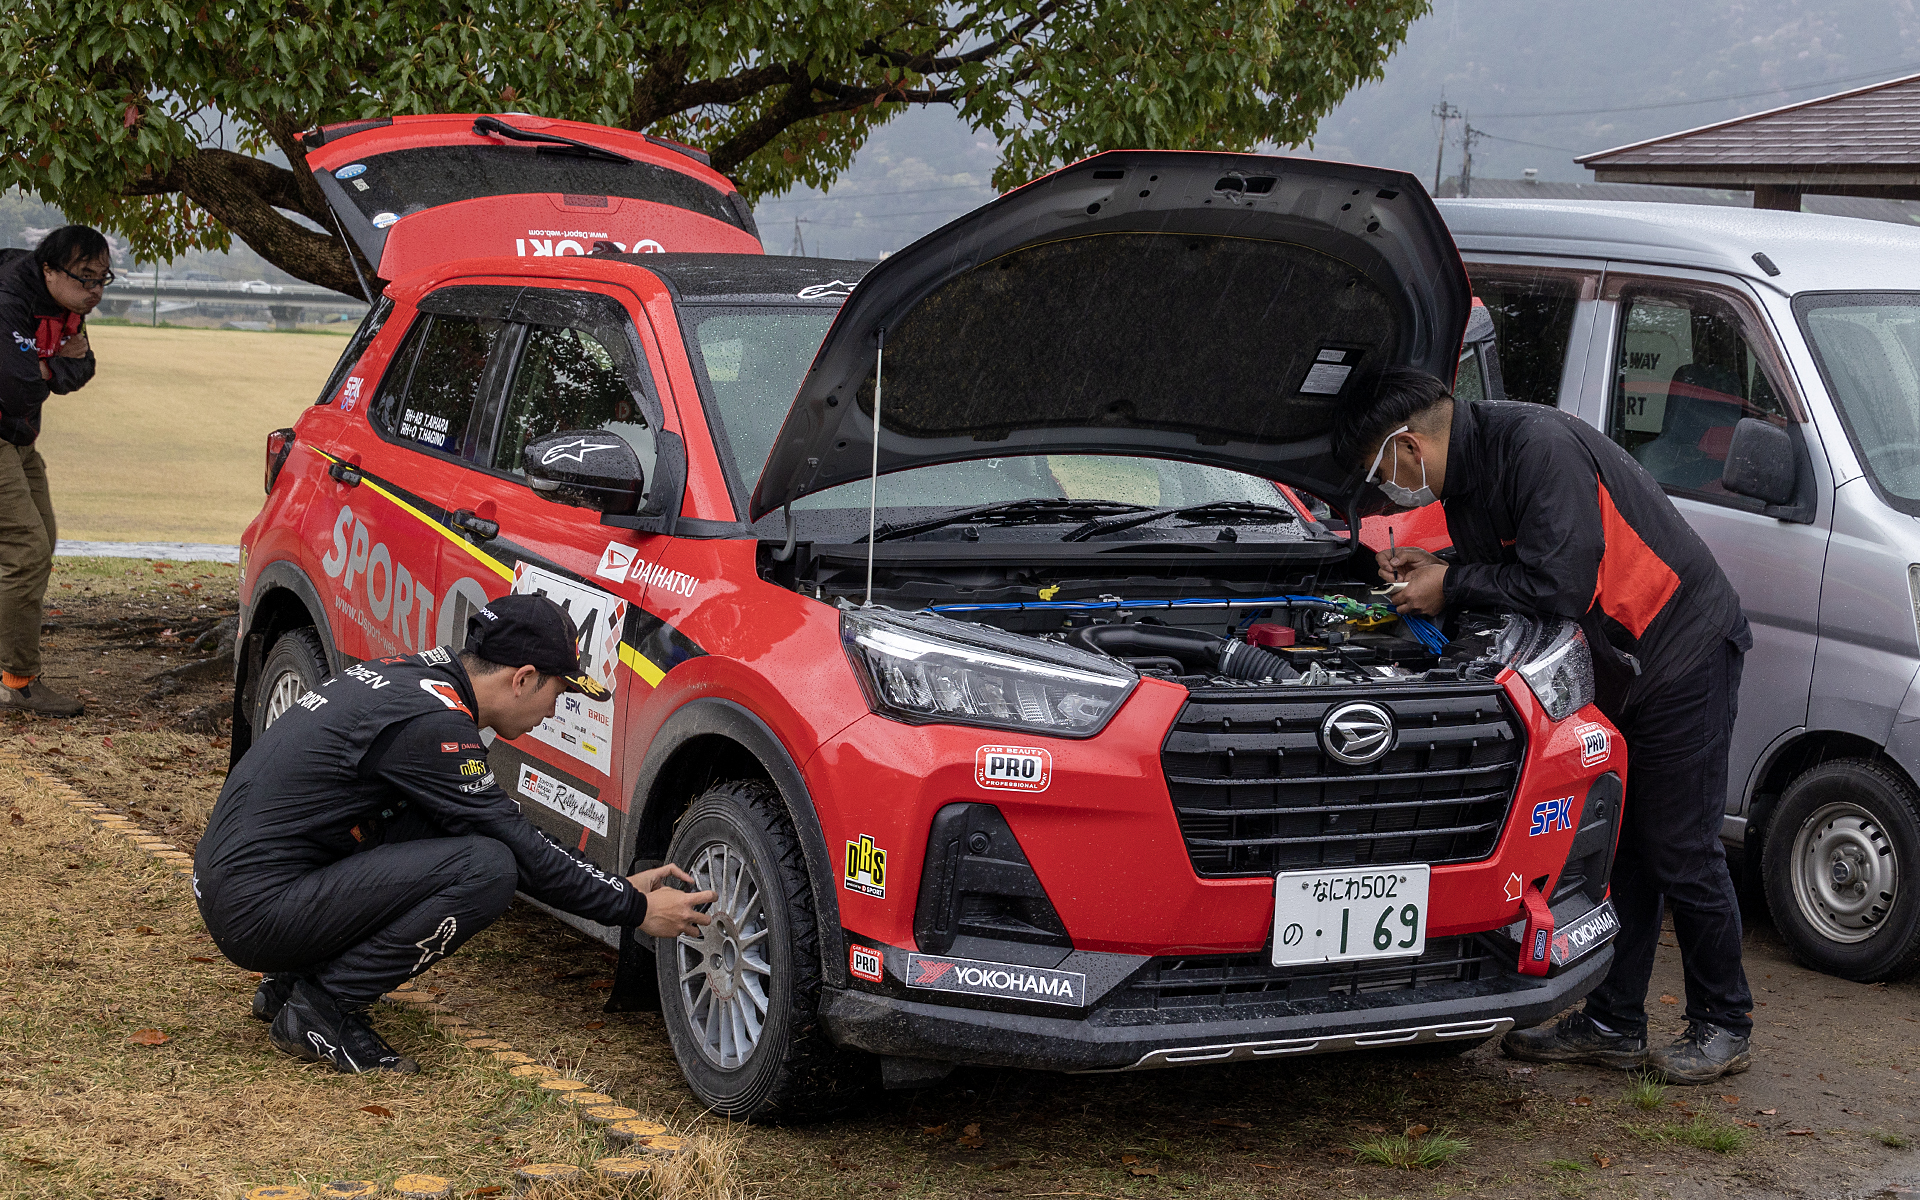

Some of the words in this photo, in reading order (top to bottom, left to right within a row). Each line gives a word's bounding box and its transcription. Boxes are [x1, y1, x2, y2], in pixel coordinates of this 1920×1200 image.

[528, 229, 608, 239] www.Dsport-web.com
[322, 505, 435, 652] SPORT
[631, 558, 700, 598] DAIHATSU
[565, 696, 581, 715] SPK
[588, 708, 610, 727] BRIDE
[1006, 747, 1043, 756] BEAUTY
[1585, 732, 1605, 755] PRO
[990, 756, 1035, 779] PRO
[985, 780, 1038, 789] PROFESSIONAL
[553, 784, 579, 817] Rally
[1529, 796, 1574, 837] SPK
[848, 836, 885, 885] DRS
[866, 886, 883, 896] SPORT
[1283, 922, 1304, 947] の
[1567, 911, 1616, 948] YOKOHAMA
[855, 953, 876, 973] PRO
[954, 966, 1074, 998] YOKOHAMA
